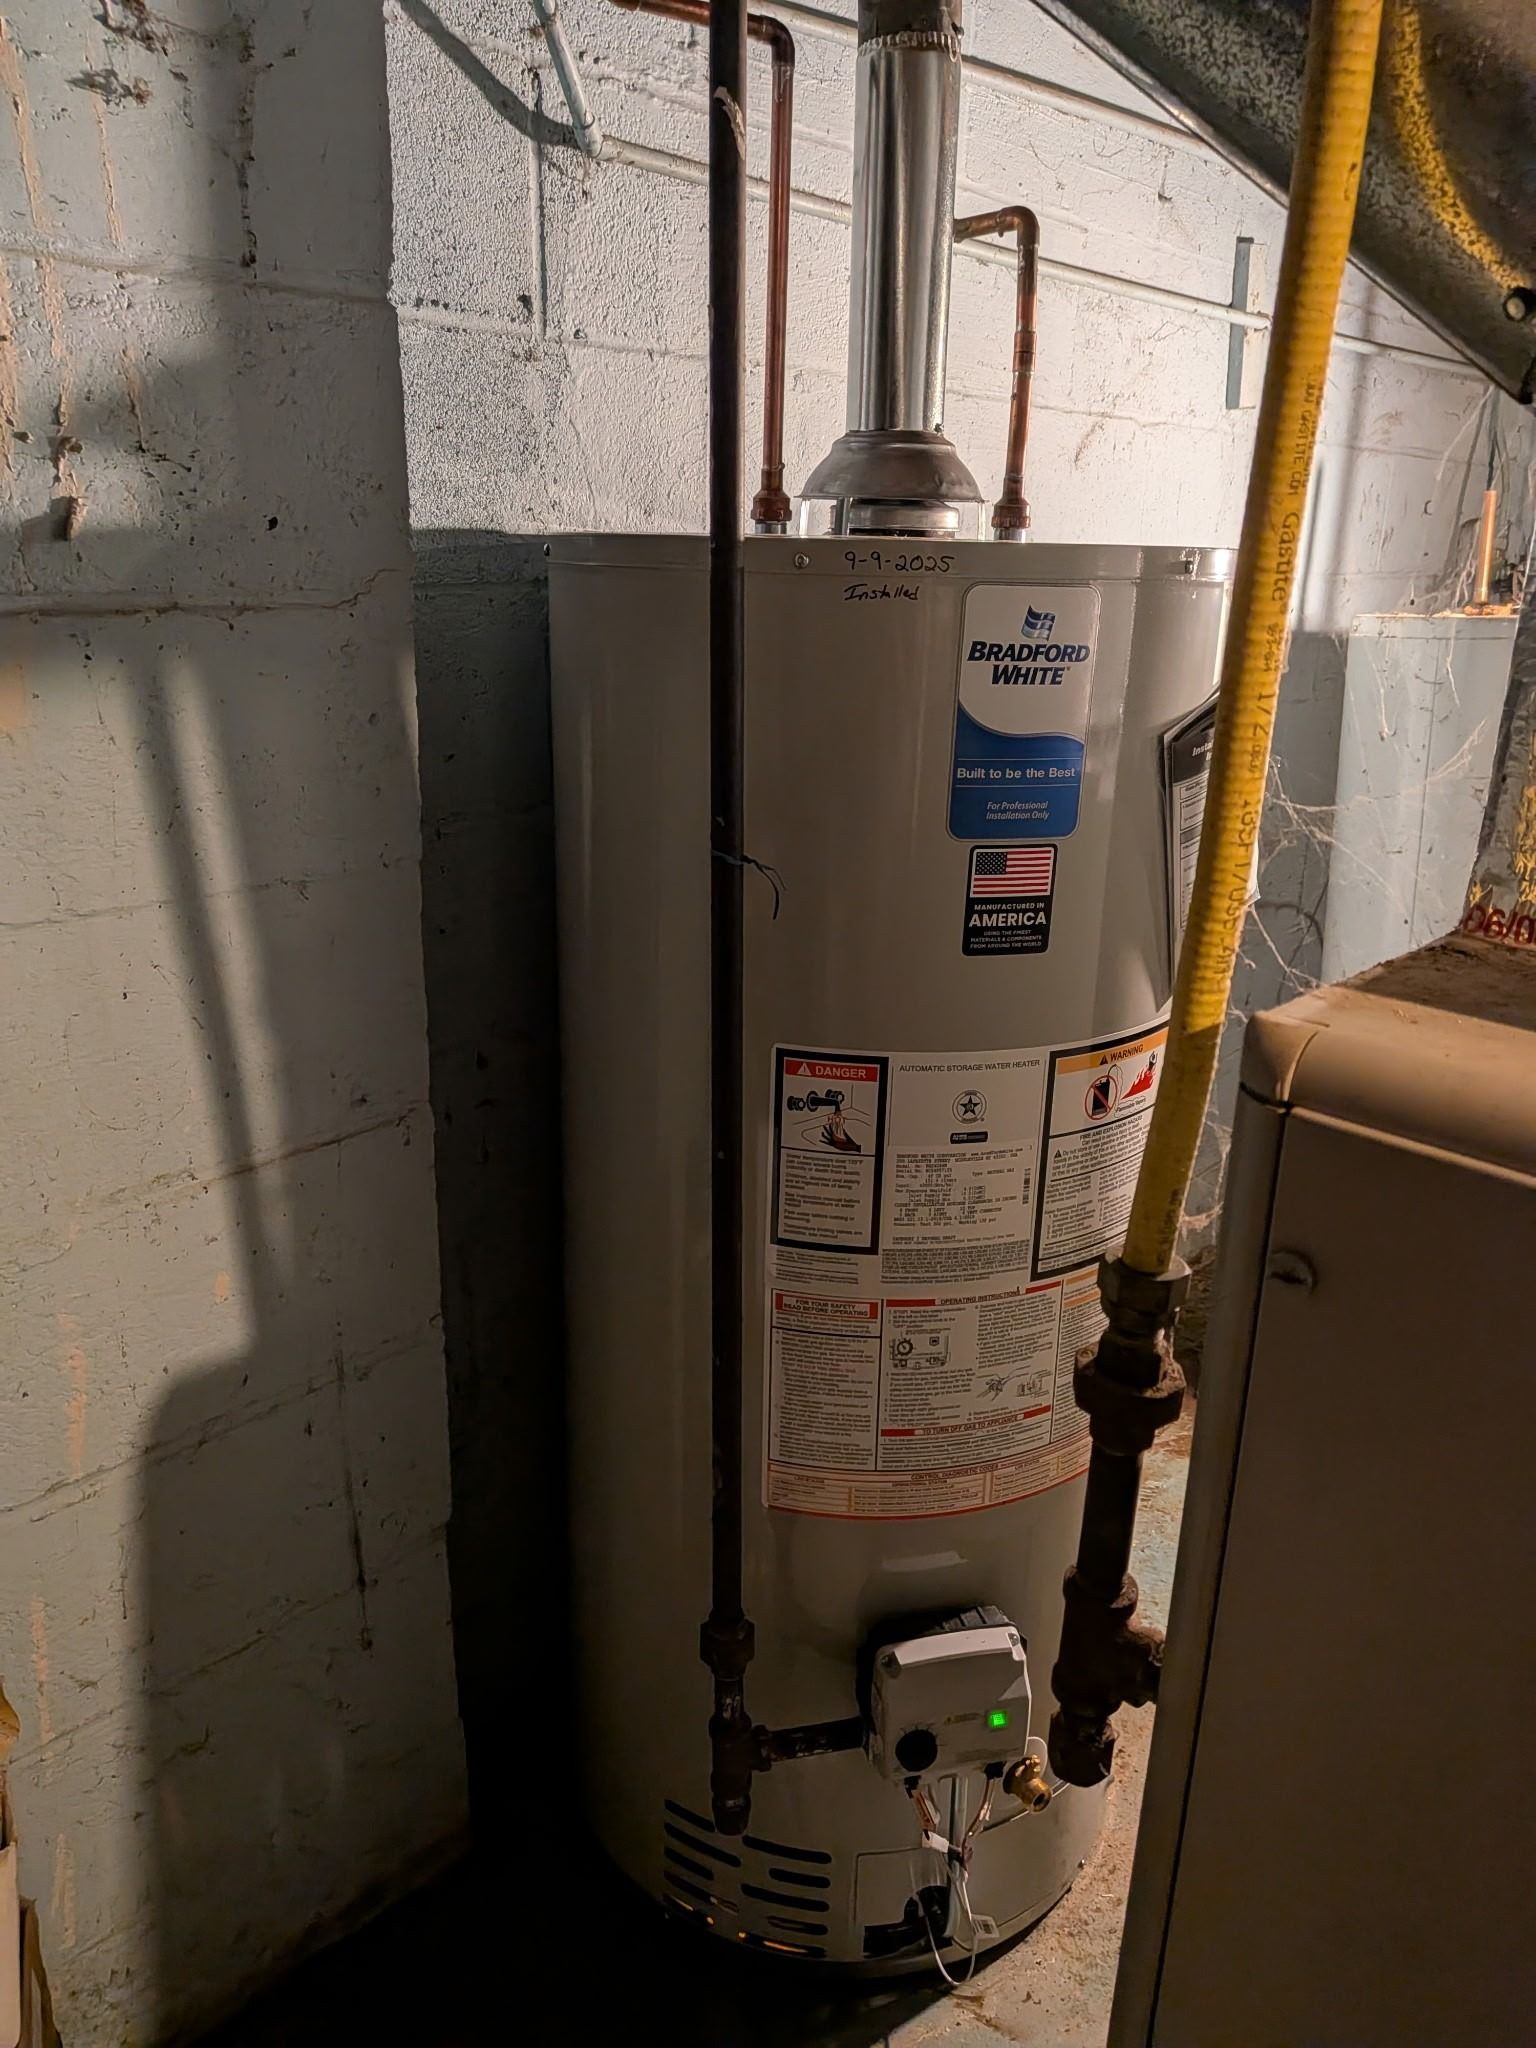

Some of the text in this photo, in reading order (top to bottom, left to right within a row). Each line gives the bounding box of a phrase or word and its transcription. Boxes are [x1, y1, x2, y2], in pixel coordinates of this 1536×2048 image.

[844, 551, 955, 573] 9-9-2025
[1272, 511, 1299, 602] Gastite
[843, 583, 919, 601] Installed
[967, 640, 1090, 663] BRADFORD
[991, 665, 1067, 686] WHITE
[957, 766, 1077, 779] Built to be the Best
[987, 800, 1048, 810] For Professional
[985, 810, 1049, 821] Installation Only
[968, 911, 1047, 928] AMERICA
[1110, 1044, 1144, 1062] WARNING
[815, 1065, 866, 1079] DANGER
[900, 1059, 1041, 1073] AUTOMATIC STORAGE WATER HEATER
